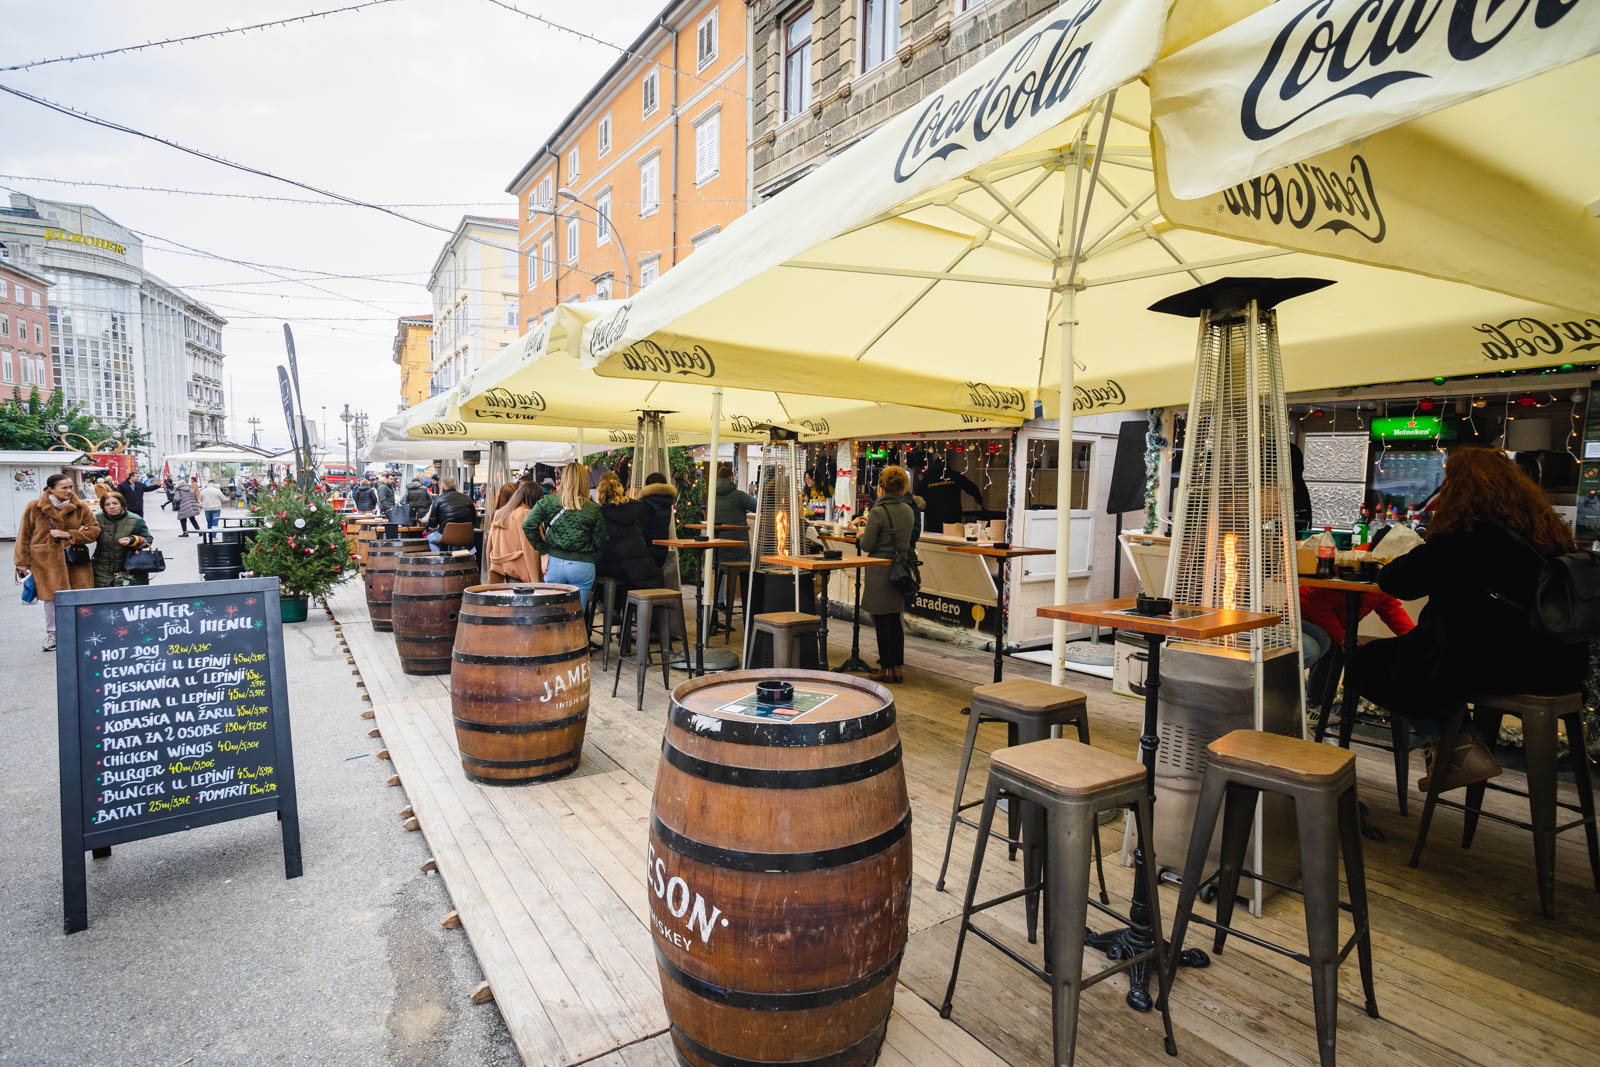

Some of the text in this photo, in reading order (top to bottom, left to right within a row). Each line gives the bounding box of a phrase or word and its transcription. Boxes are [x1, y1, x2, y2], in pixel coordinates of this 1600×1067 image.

[894, 0, 1101, 183] Coca-Cola
[44, 228, 126, 257] EUROHERC
[912, 593, 961, 616] aradero
[101, 646, 129, 662] HOT
[555, 697, 580, 710] IRISH
[175, 711, 195, 723] NA
[102, 735, 143, 752] PLATA
[164, 726, 175, 742] 2
[176, 722, 223, 740] OSOBE
[94, 802, 147, 825] BATAT
